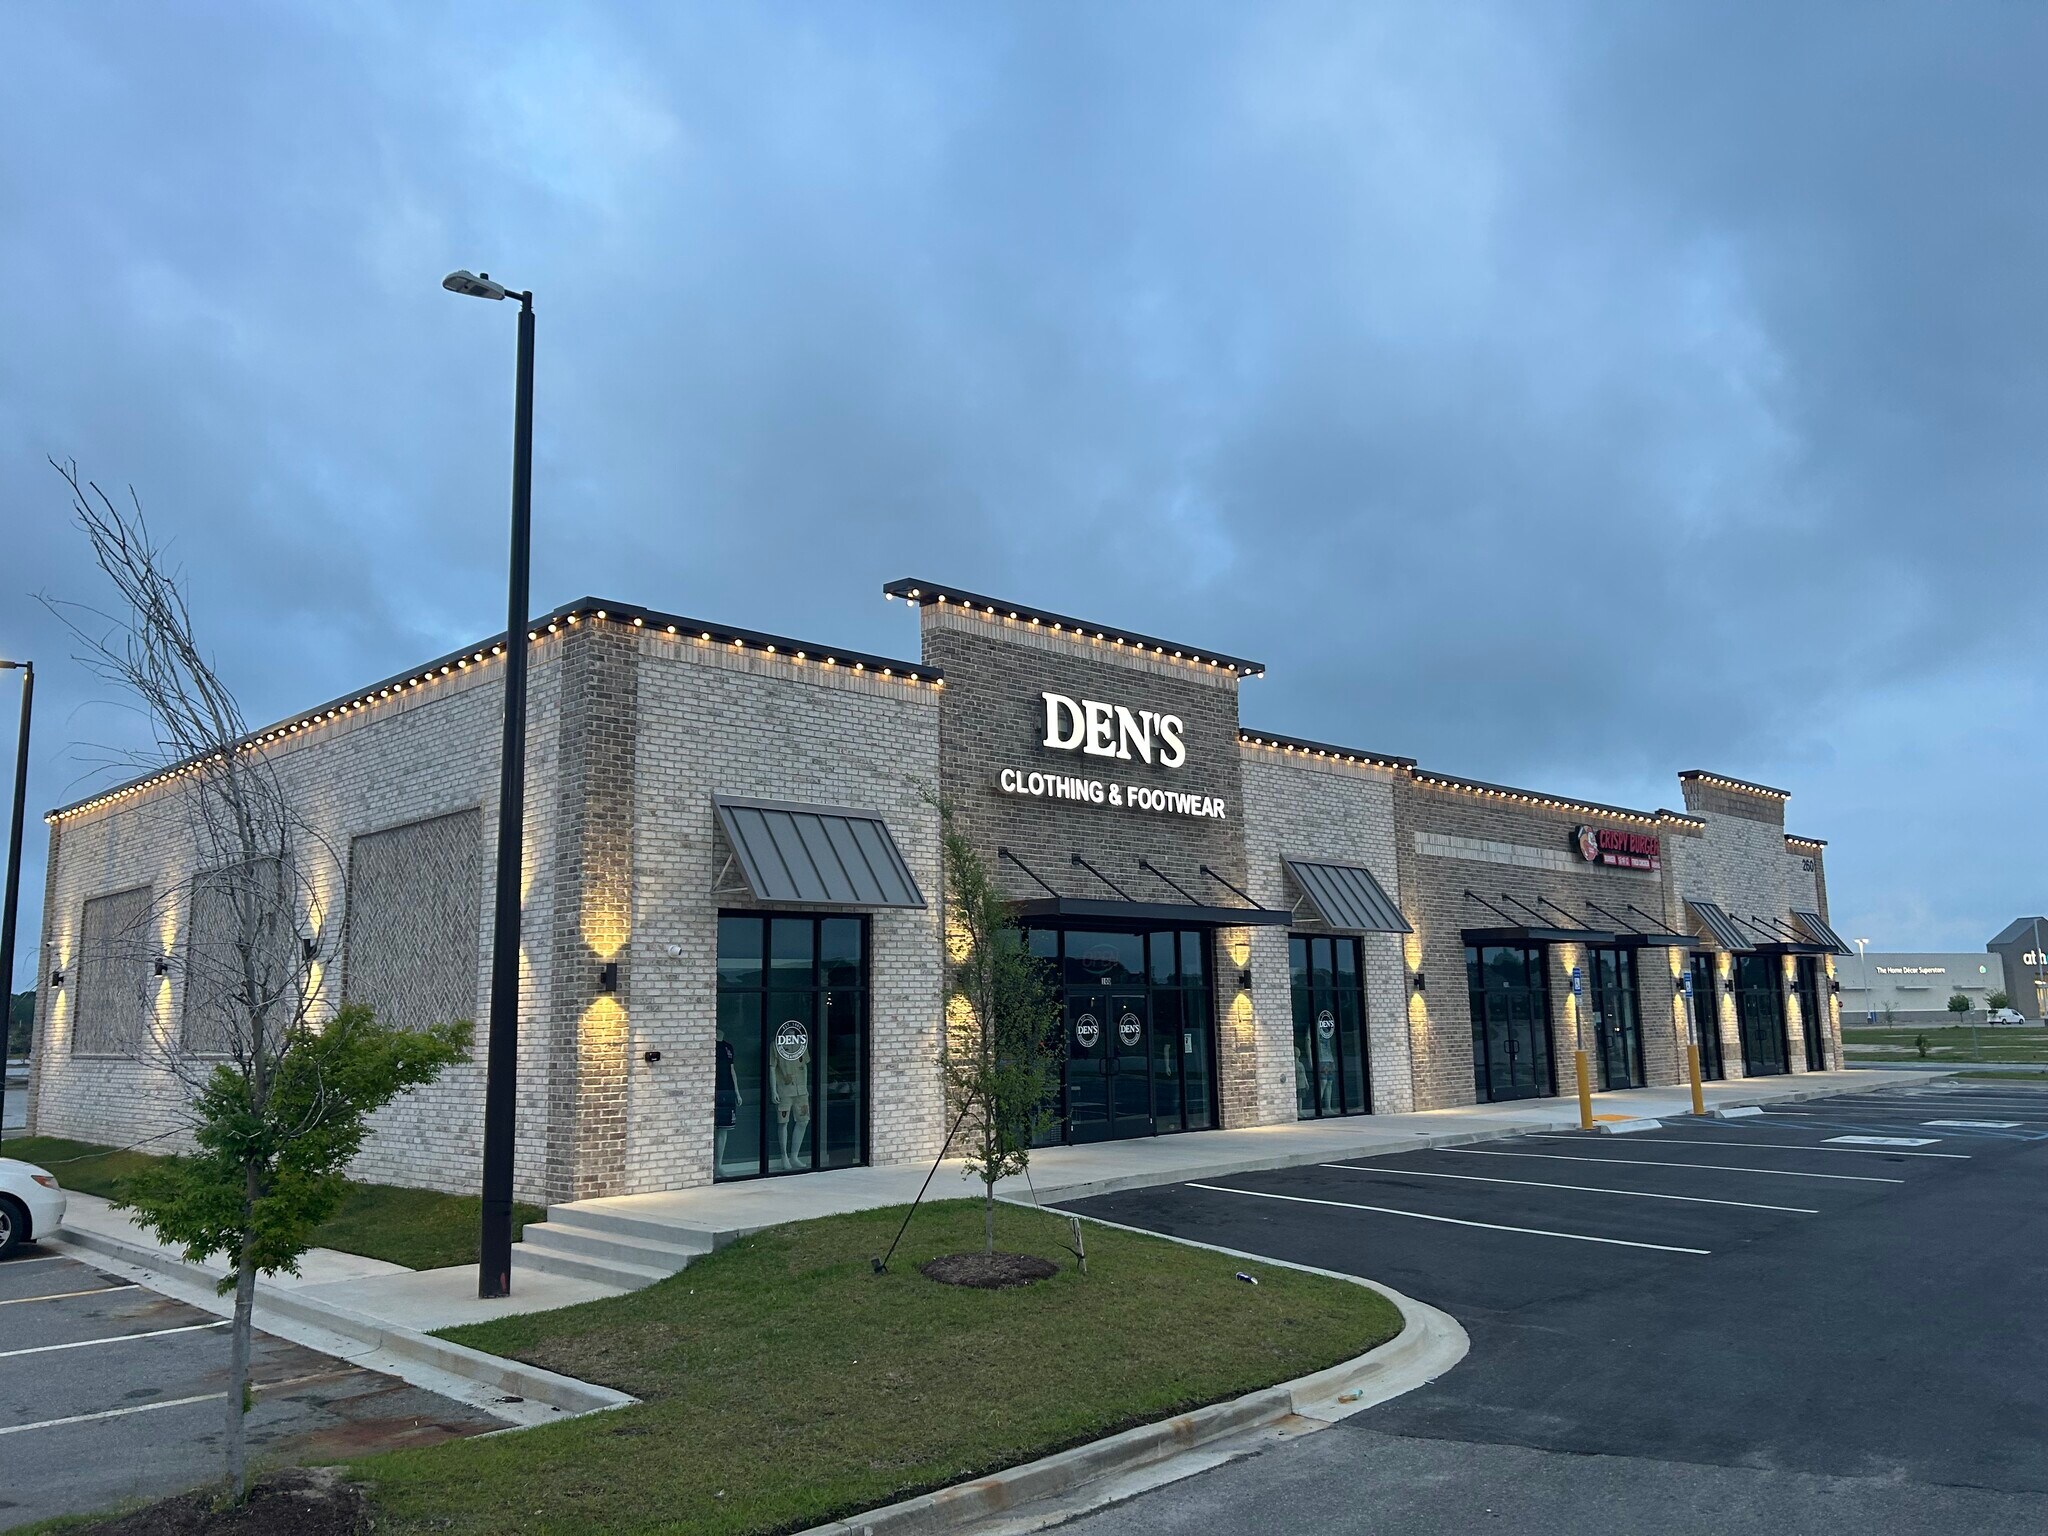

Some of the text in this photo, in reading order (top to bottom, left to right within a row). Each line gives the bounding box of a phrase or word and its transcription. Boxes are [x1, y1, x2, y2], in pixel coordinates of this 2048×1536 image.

[1042, 692, 1186, 768] DEN'S
[1000, 768, 1226, 819] CLOTHING & FOOTWEAR
[1600, 829, 1659, 855] CRISPY BURGER
[2023, 948, 2048, 966] at h
[1876, 966, 1887, 974] The
[1888, 966, 1902, 974] Home
[1919, 966, 1946, 975] Superstore
[1078, 1025, 1099, 1035] DEN'S
[1120, 1024, 1140, 1034] DEN'S
[777, 1034, 807, 1045] DEN'S
